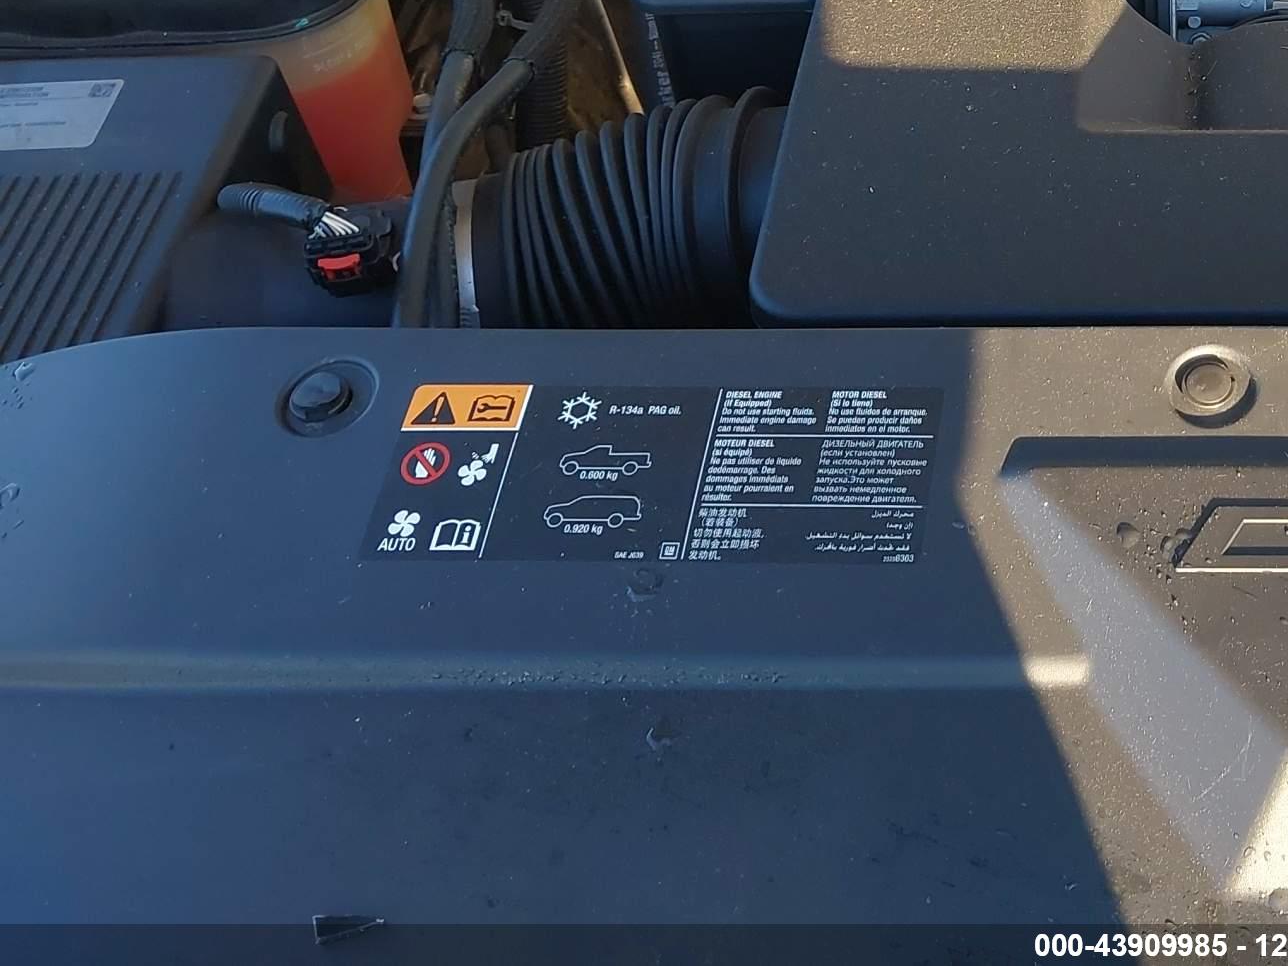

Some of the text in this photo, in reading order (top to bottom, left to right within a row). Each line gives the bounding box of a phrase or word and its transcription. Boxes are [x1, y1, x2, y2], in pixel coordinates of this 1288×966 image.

[726, 390, 782, 399] DIESEL ENGINE
[832, 390, 887, 399] MOTOR DIESEL
[723, 399, 772, 408] (If Equipped)
[830, 399, 873, 408] (Si lo tiene)
[609, 405, 682, 415] R-134a PAG oil.
[762, 408, 791, 416] starting
[893, 409, 928, 417] arranque.
[719, 416, 817, 425] Immediate engine damage
[827, 416, 922, 425] Se pueden producir daños
[887, 425, 910, 433] motor.
[714, 439, 746, 447] MOTEUR
[821, 439, 924, 449] ДИЗЕЛЬНЫЙ ДВИГАТЕЛЬ
[712, 448, 752, 457] (si équipé)
[820, 449, 896, 458] (если установлен)
[710, 457, 802, 466] Ne pas utiliser de liquide
[832, 458, 885, 467] используйте
[887, 459, 928, 467] пусковые
[761, 466, 776, 474] Des
[876, 468, 921, 476] холодного
[579, 471, 618, 481] 0.600 kg
[705, 475, 789, 484] dommages immédiats
[714, 484, 743, 492] moteur
[743, 484, 783, 493] pourraient
[849, 486, 907, 494] немедленное
[701, 493, 732, 501] résulter.
[811, 495, 917, 503] повреждение двигателя.
[563, 524, 603, 535] 0.920 kg
[377, 538, 416, 551] AUTO
[614, 551, 626, 559] SAE
